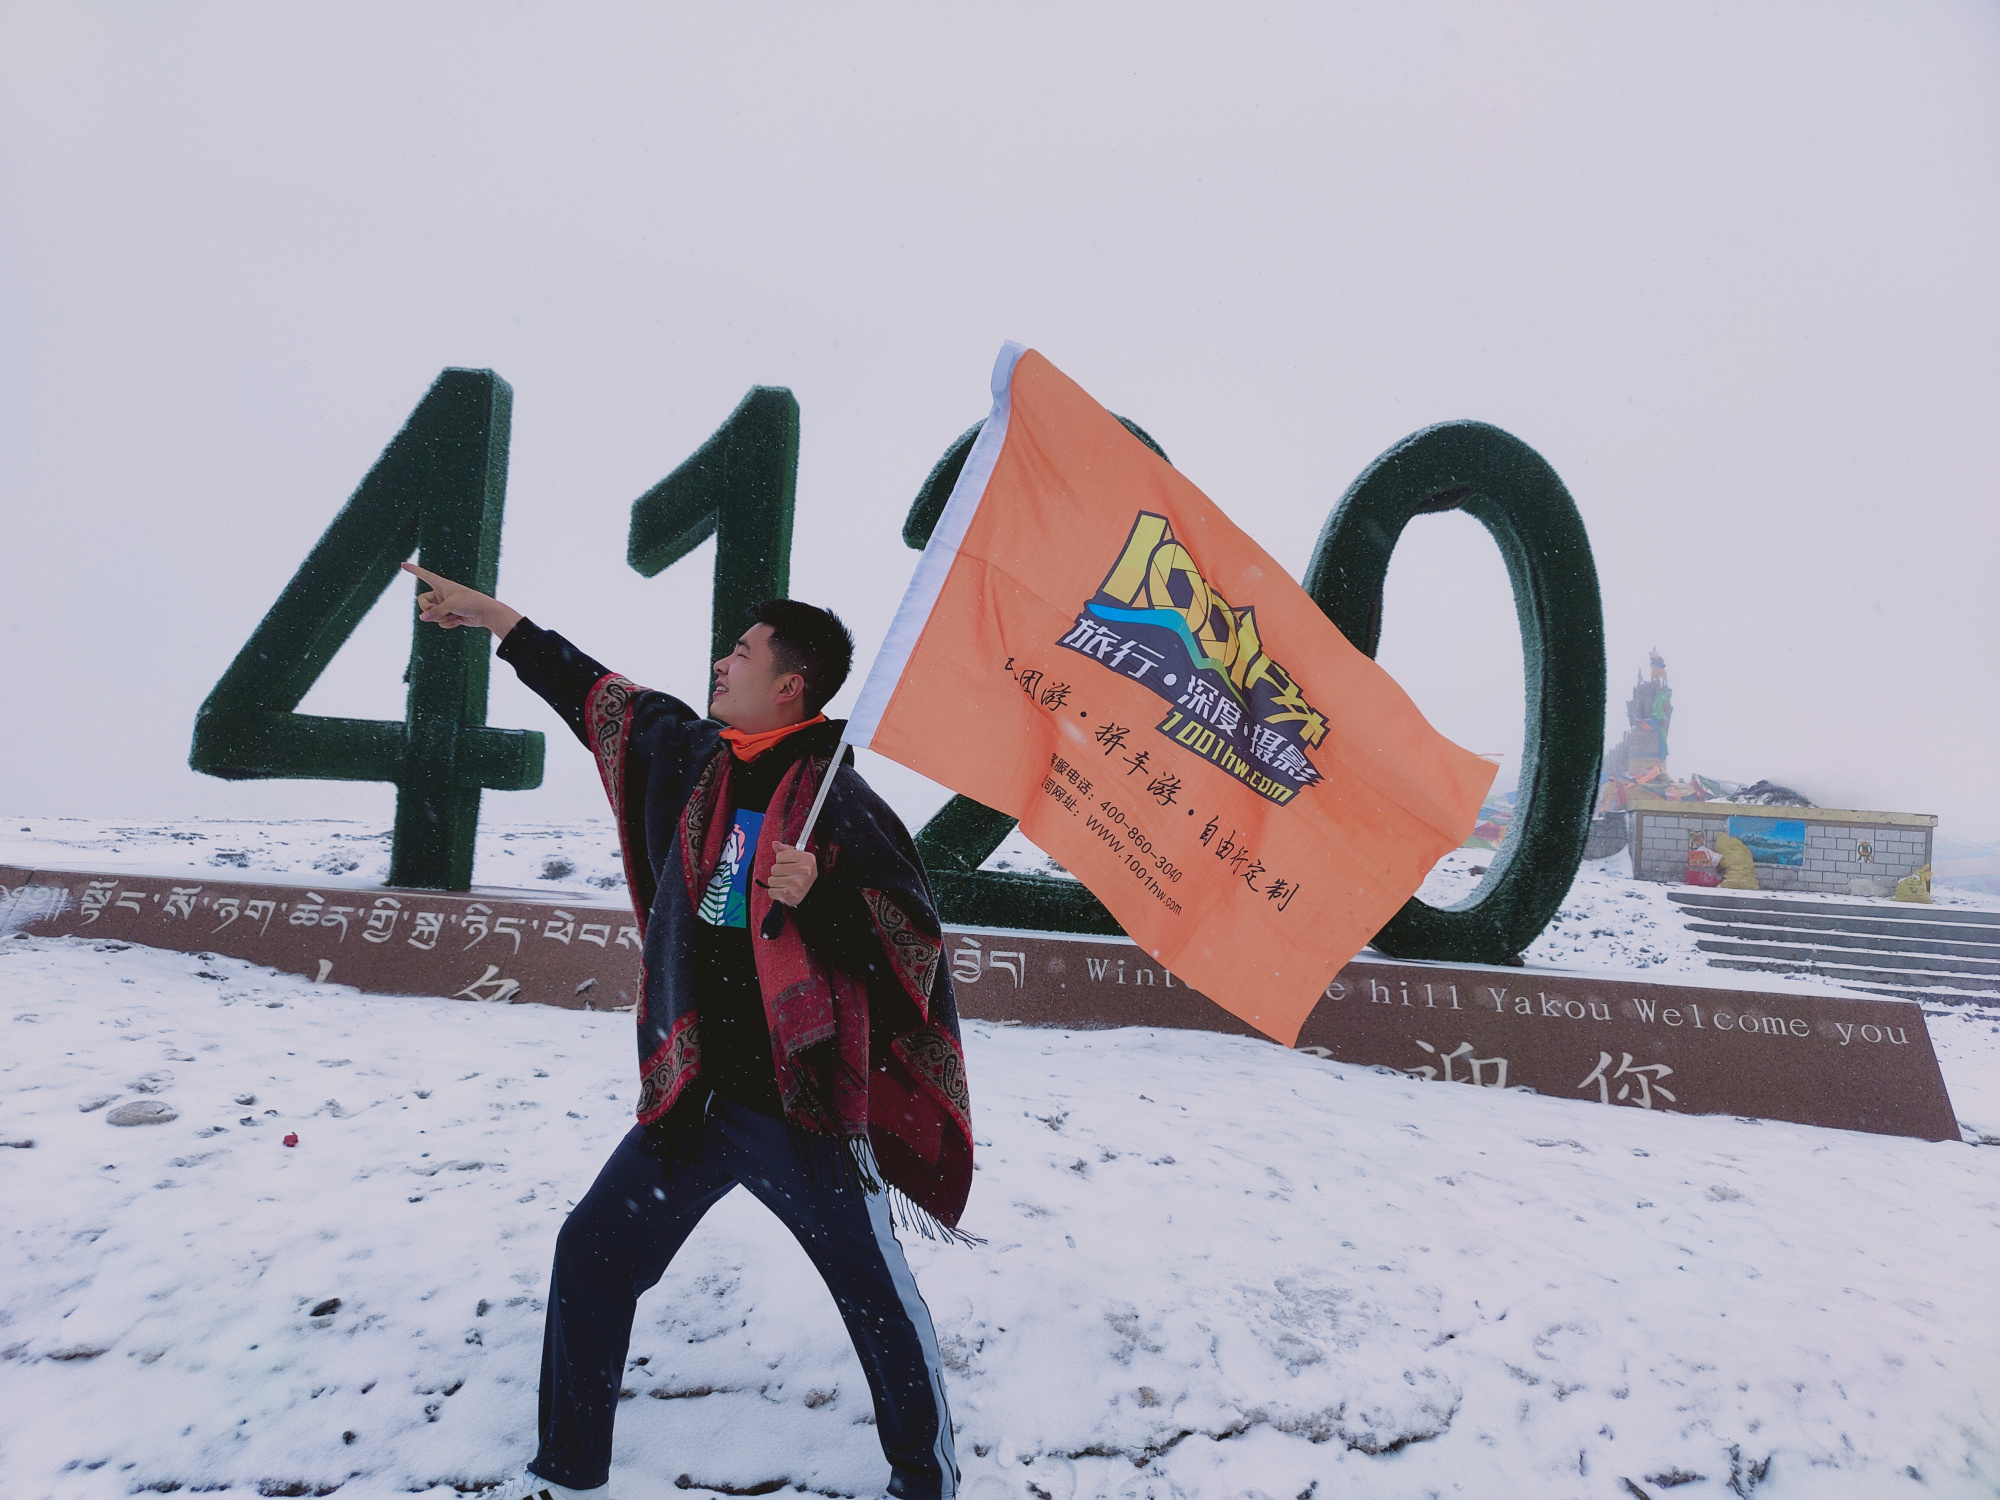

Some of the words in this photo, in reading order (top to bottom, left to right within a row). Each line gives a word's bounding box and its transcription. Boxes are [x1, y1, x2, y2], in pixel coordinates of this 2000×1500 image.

[1161, 710, 1294, 803] 1001hw.com
[1085, 956, 1198, 991] Wint
[1370, 978, 1462, 1011] hill
[1486, 986, 1612, 1022] Yakou
[1632, 997, 1811, 1039] Welcome
[1834, 1021, 1911, 1047] you
